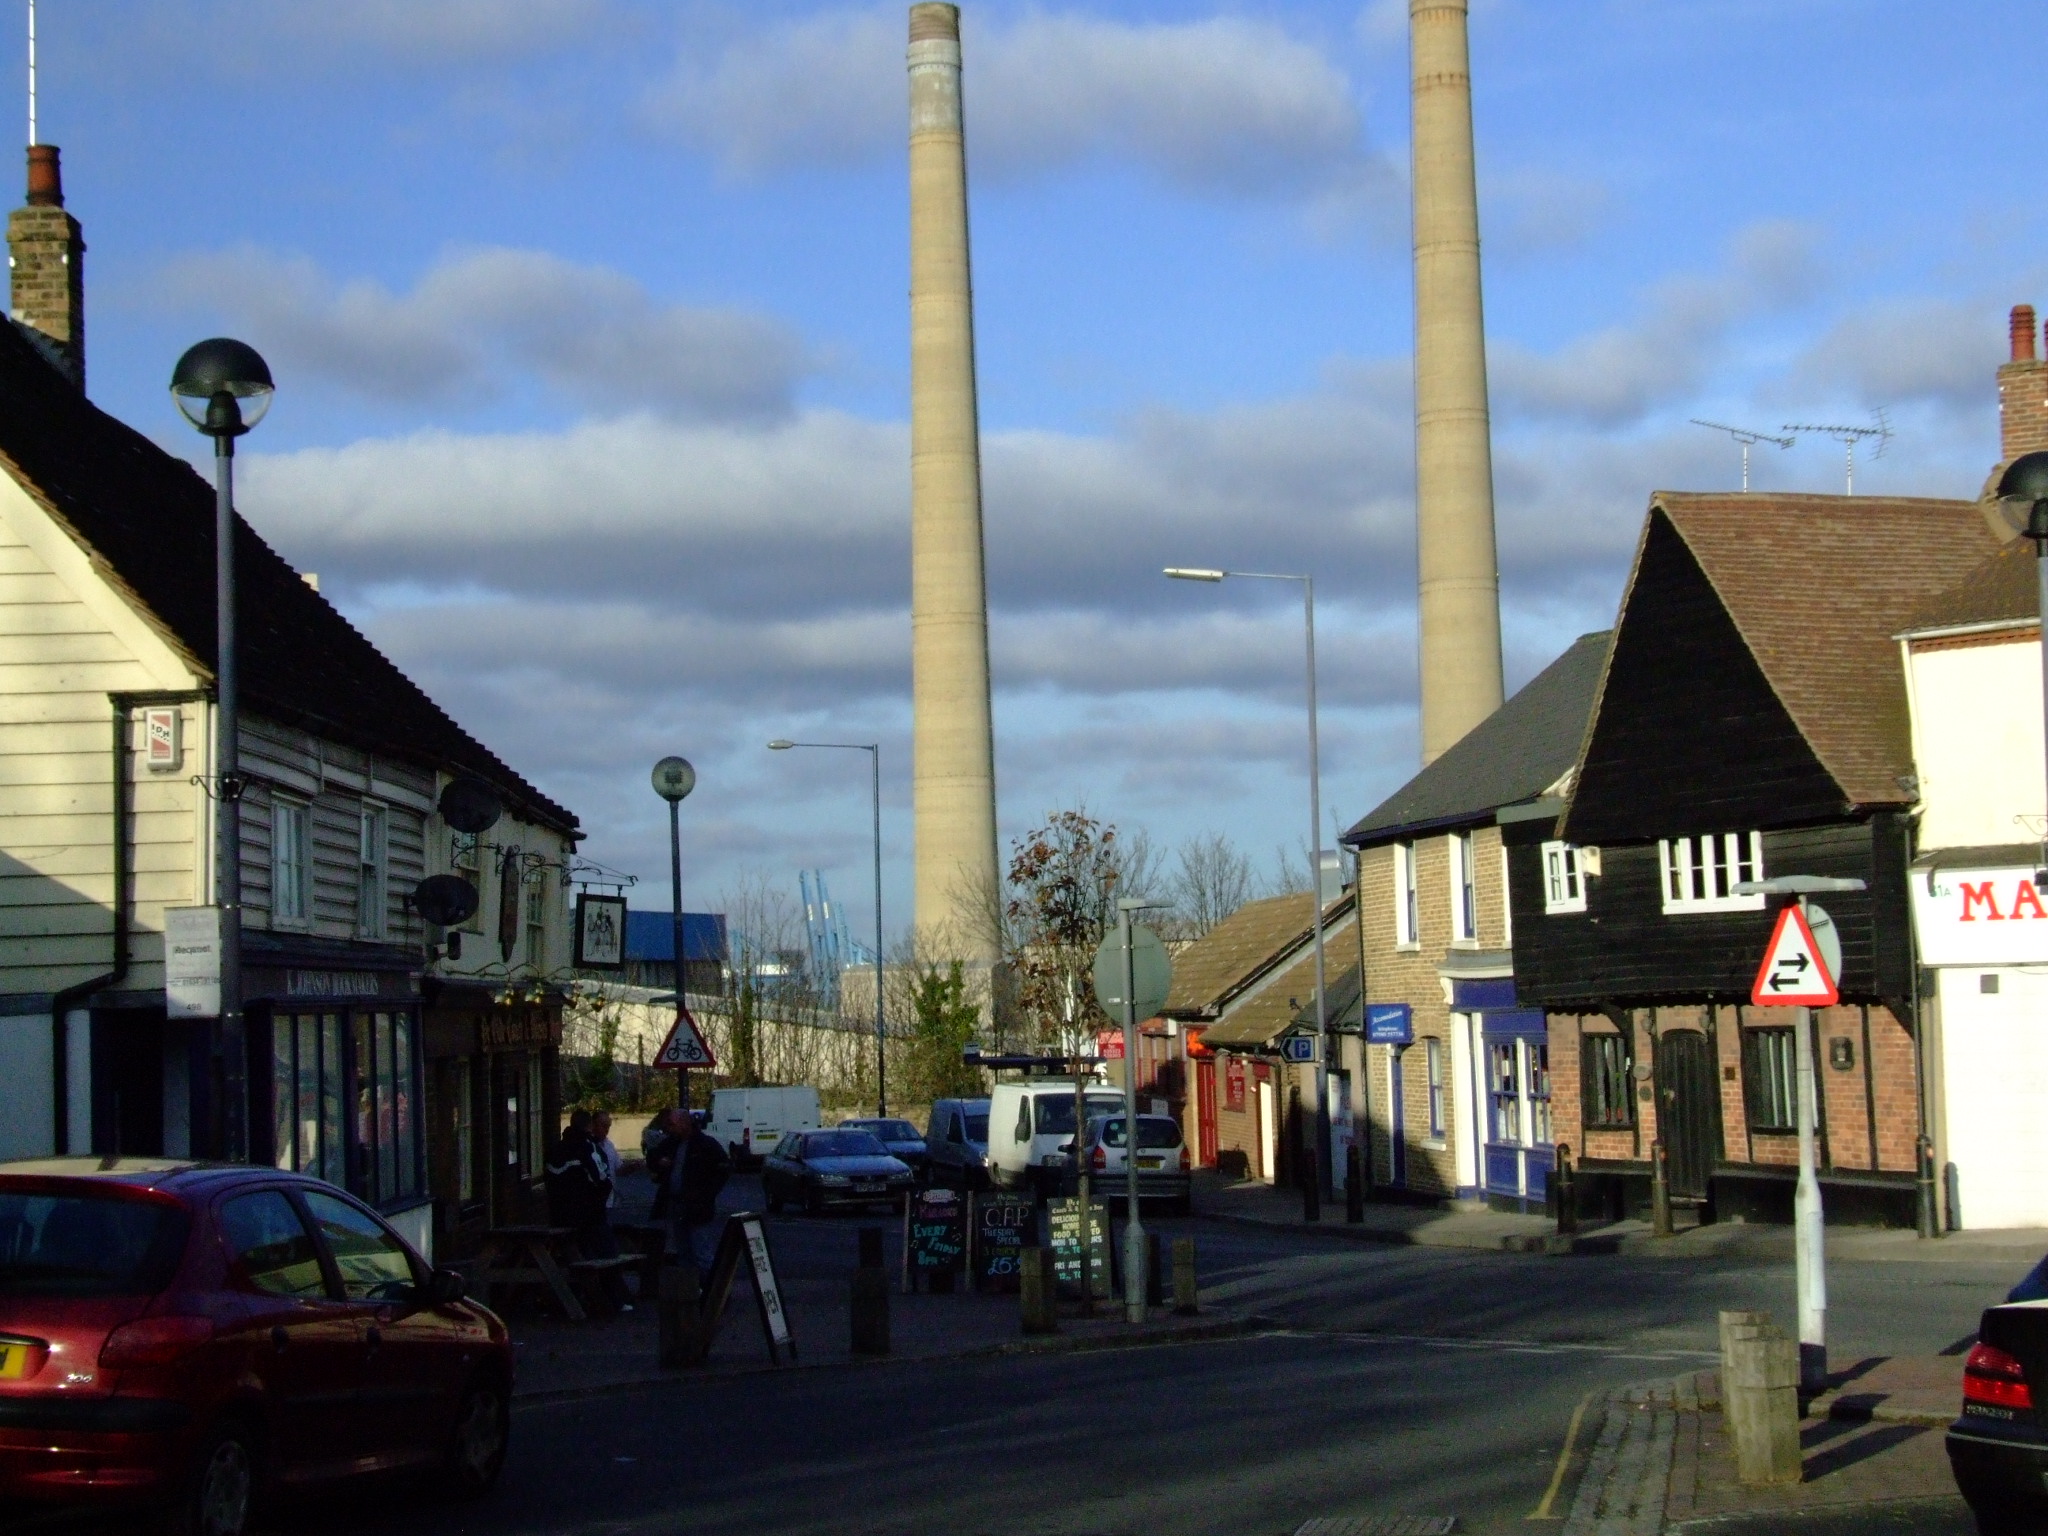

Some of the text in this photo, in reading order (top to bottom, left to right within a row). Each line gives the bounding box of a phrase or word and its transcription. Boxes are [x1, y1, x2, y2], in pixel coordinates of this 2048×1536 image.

[913, 1223, 948, 1239] EVERY
[1053, 1230, 1071, 1239] FOOD
[1068, 1237, 1078, 1246] TO
